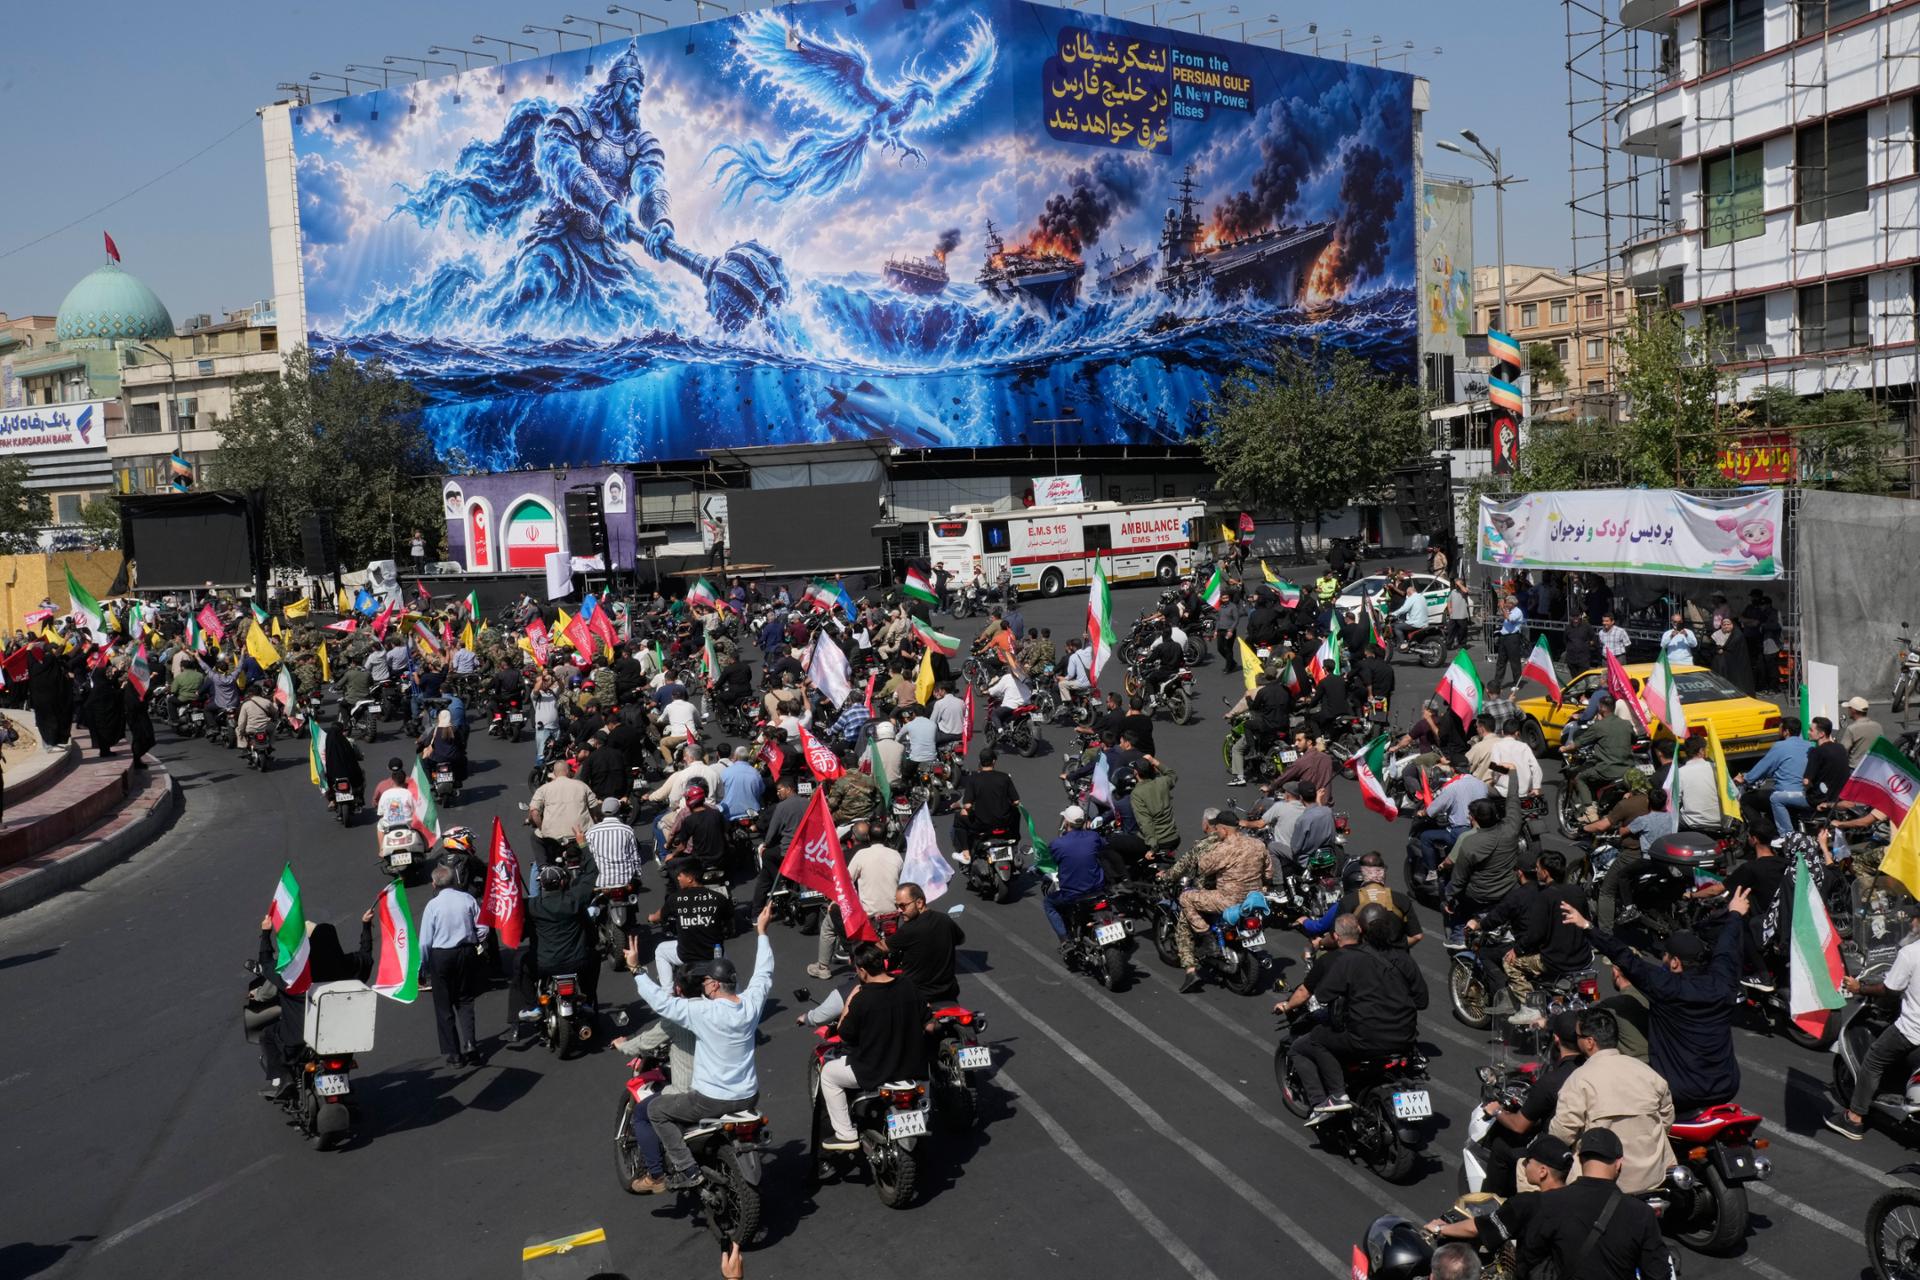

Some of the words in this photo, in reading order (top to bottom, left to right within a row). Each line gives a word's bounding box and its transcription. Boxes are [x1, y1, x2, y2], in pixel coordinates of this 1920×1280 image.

[1061, 32, 1119, 67] شیطان
[1119, 43, 1166, 73] لشکر
[1172, 49, 1204, 68] From
[1208, 56, 1229, 72] the
[1051, 67, 1100, 100] فارس
[1172, 67, 1221, 88] PERSIAN
[1222, 74, 1250, 92] GULF
[1102, 76, 1148, 107] خلیج
[1149, 88, 1168, 112] در
[1173, 84, 1182, 99] A
[1185, 86, 1211, 102] New
[1214, 90, 1249, 109] Power
[1050, 107, 1078, 131] شد
[1174, 103, 1204, 119] Rises
[1081, 110, 1135, 144] خواهد
[1137, 118, 1169, 149] غرق
[20, 412, 45, 432] رفاه
[45, 411, 71, 431] بانک
[52, 433, 73, 444] BANK
[1028, 526, 1051, 537] E.M.S
[1054, 524, 1067, 535] 115
[1121, 519, 1179, 536] AMBULANCE
[1132, 536, 1151, 544] EMS
[1156, 534, 1170, 542] 115
[1550, 519, 1585, 542] نوجوان
[1586, 526, 1593, 542] و
[1595, 519, 1630, 543] کودک
[1629, 523, 1674, 546] پردیس
[692, 905, 718, 914] story
